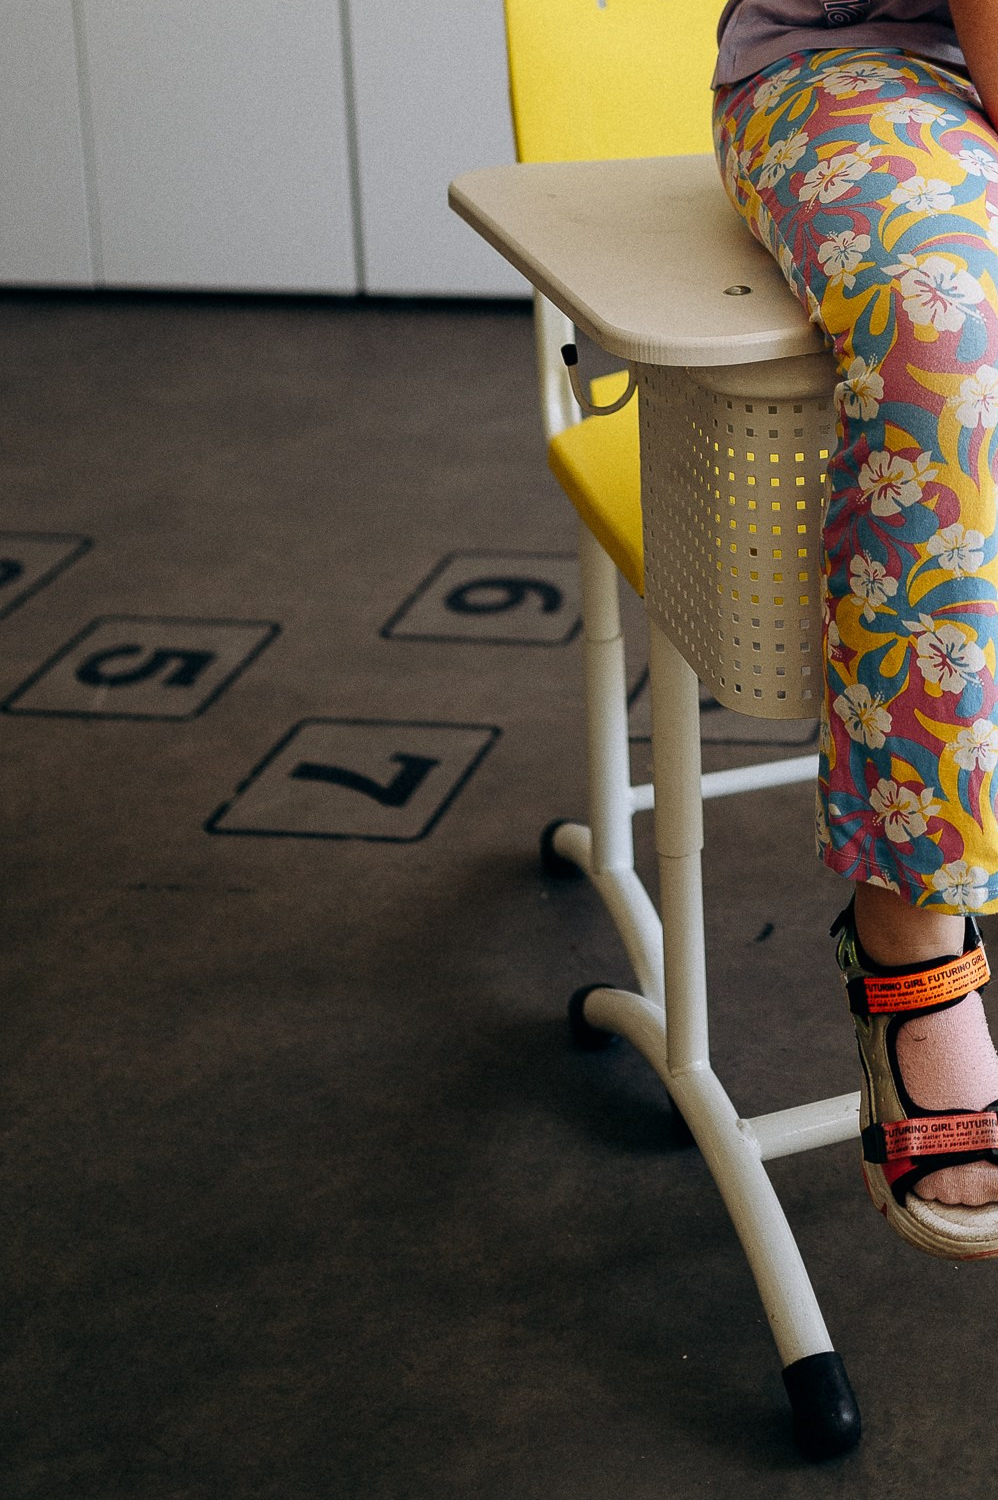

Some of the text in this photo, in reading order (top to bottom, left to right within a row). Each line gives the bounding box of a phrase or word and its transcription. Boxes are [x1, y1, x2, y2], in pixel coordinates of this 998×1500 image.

[442, 575, 564, 616] 6
[74, 642, 219, 689] 5
[289, 751, 441, 809] 7
[903, 978, 927, 990] GIRL
[927, 961, 971, 985] FUTURINO
[971, 953, 985, 967] GIRL
[930, 1123, 955, 1133] GIRL
